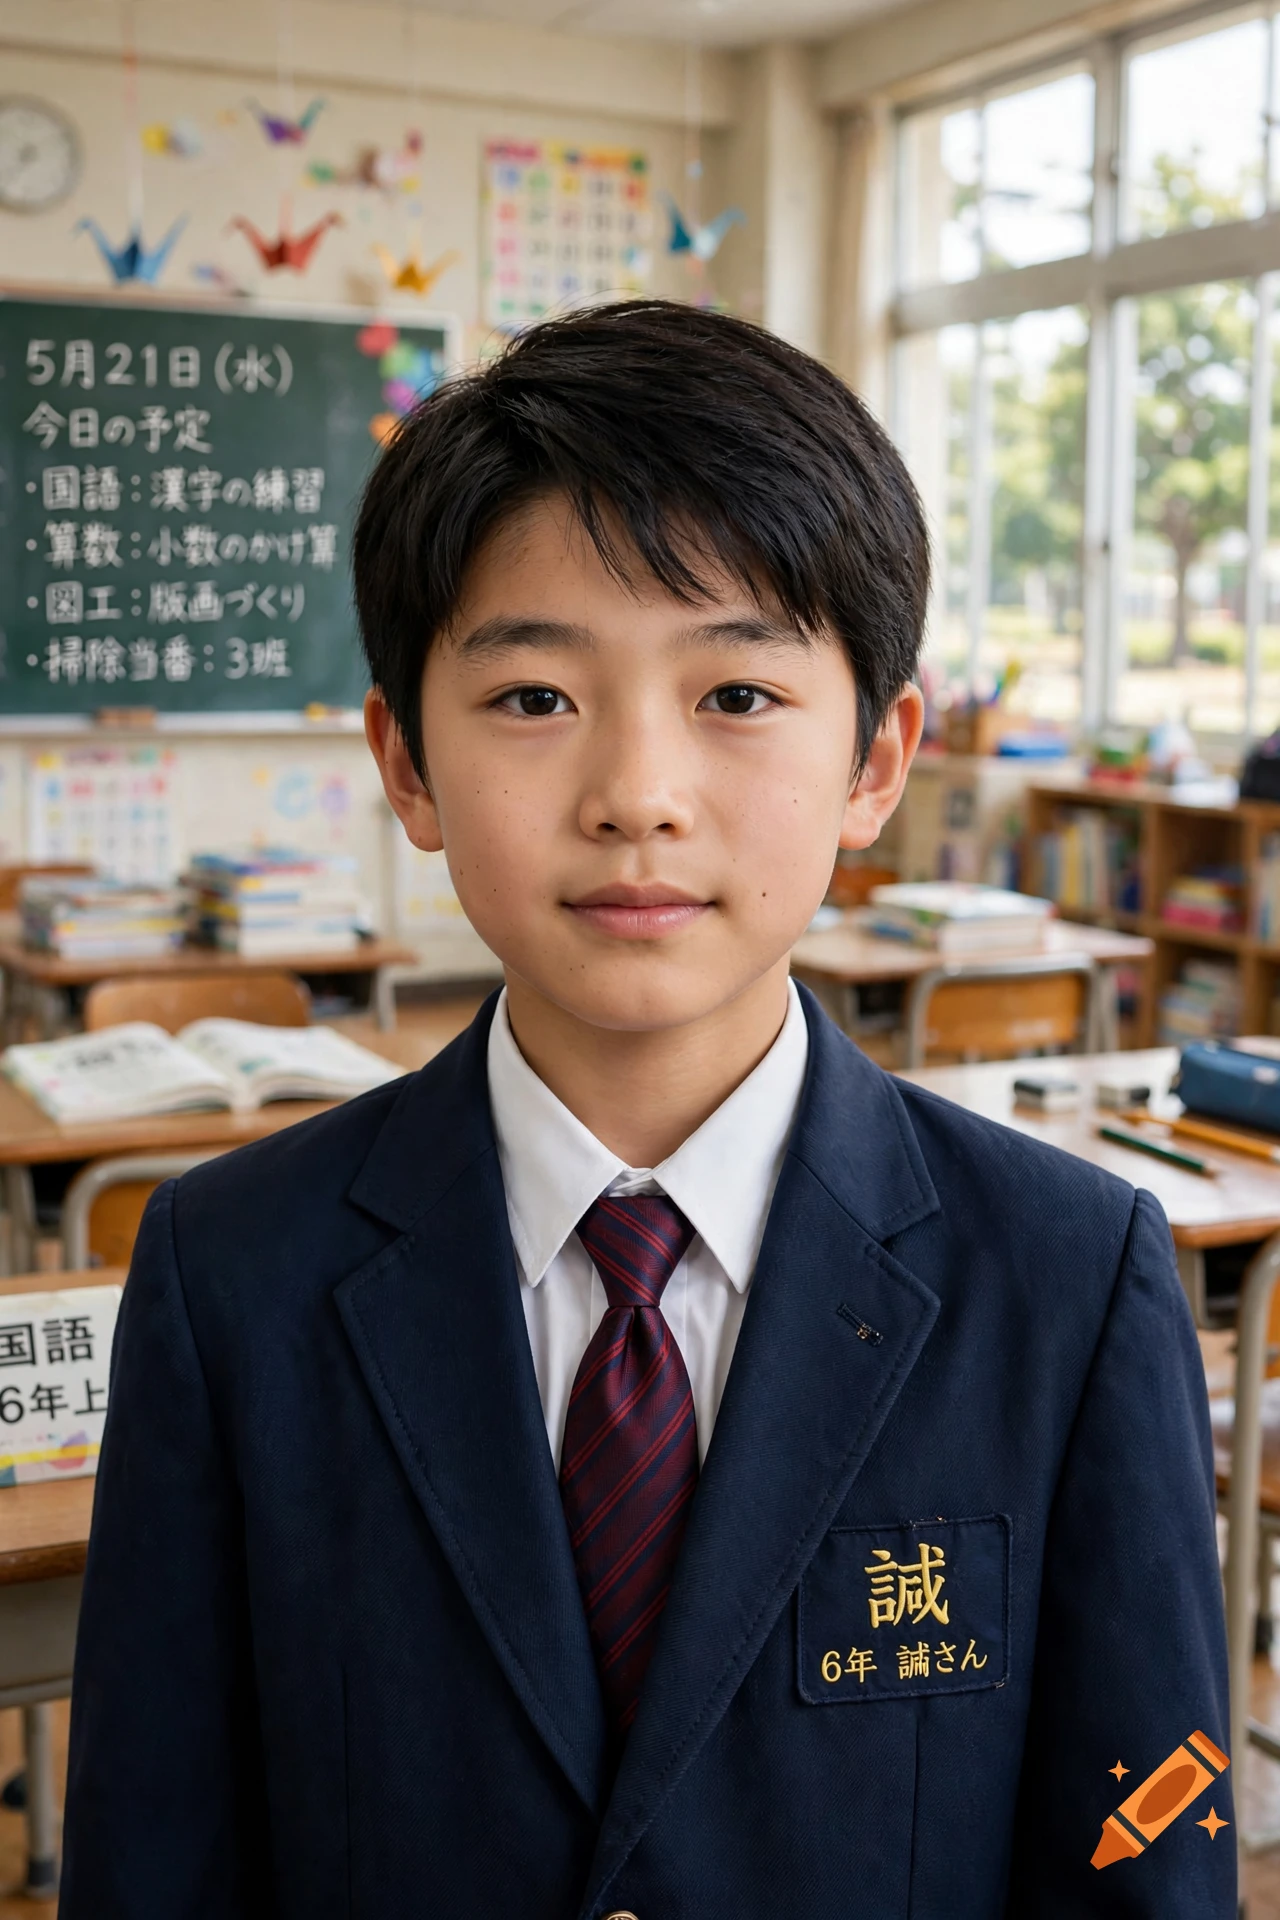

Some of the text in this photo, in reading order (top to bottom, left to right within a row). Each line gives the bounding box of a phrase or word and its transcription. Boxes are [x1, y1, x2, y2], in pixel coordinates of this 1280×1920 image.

[22, 401, 213, 453] 今日の予定
[0, 1315, 94, 1367] 国語
[0, 1377, 108, 1424] 6年上
[821, 1646, 877, 1684] 6年
